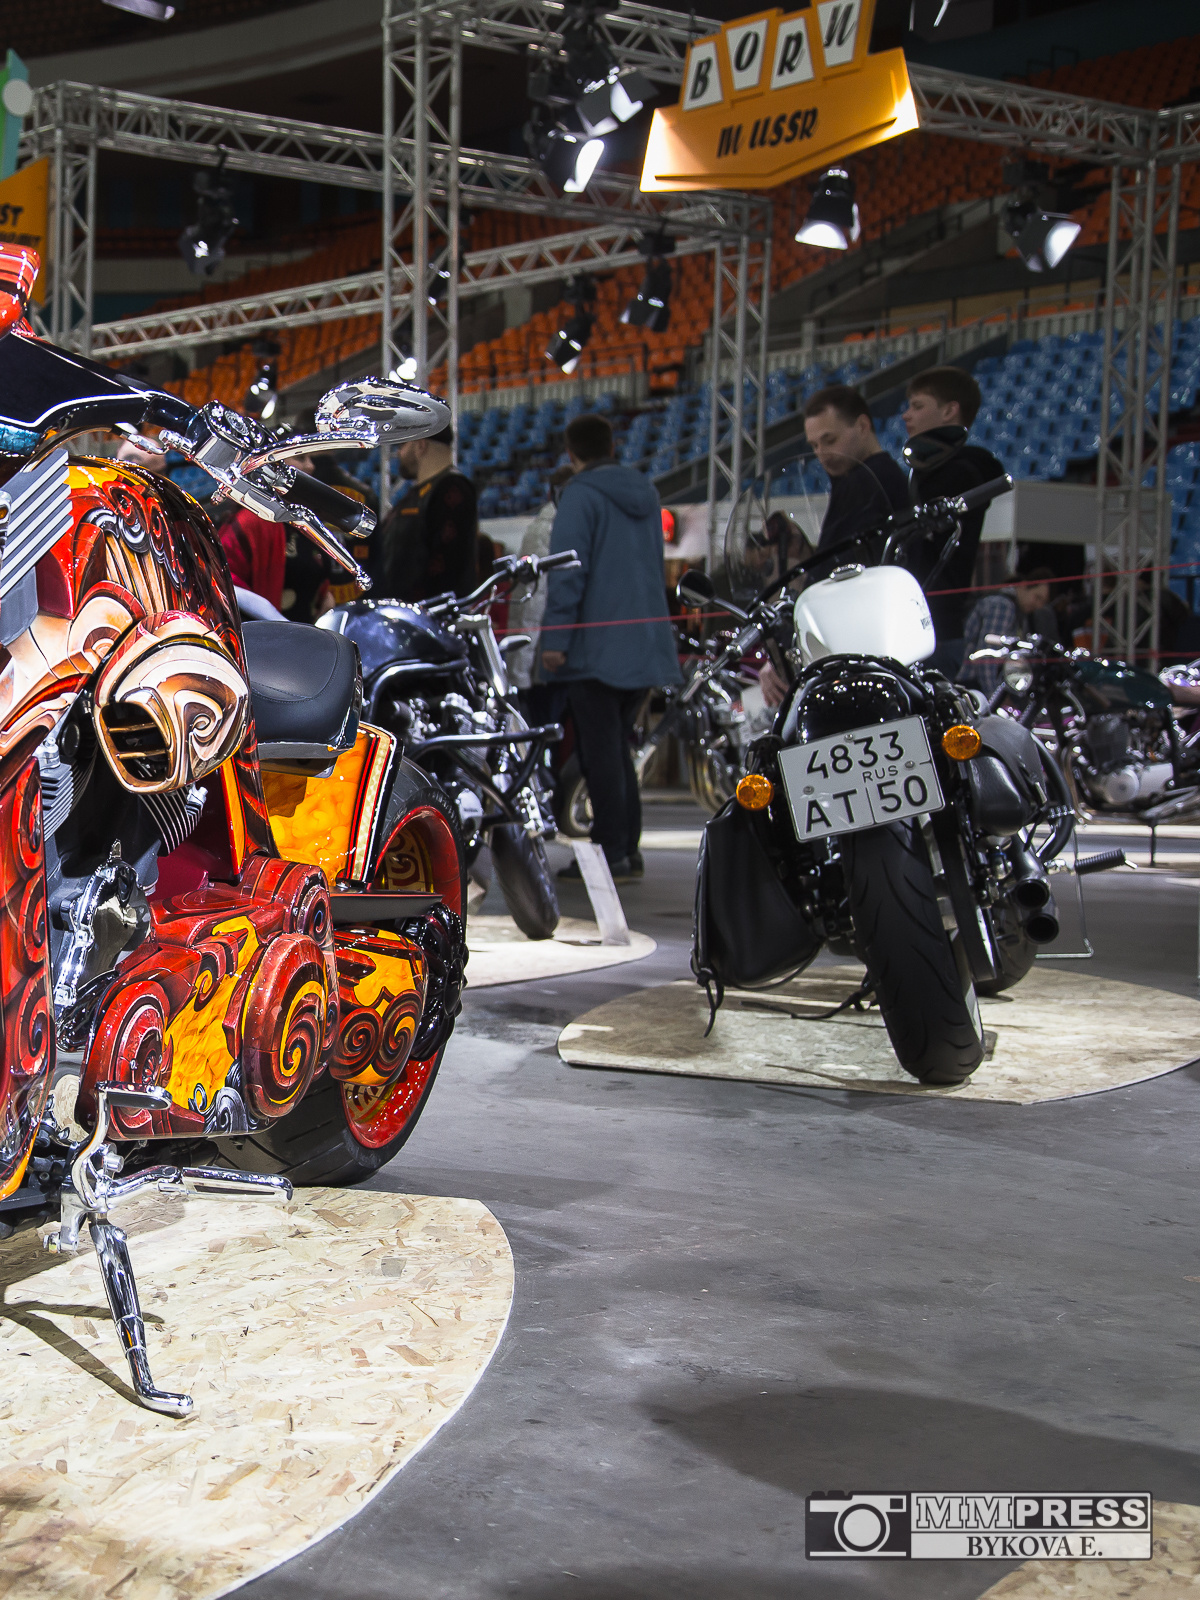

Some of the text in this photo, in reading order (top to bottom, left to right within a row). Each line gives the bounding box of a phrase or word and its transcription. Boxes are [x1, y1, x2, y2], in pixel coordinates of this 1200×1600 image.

[689, 2, 858, 101] BORN
[716, 106, 819, 158] IN USSR
[806, 730, 905, 780] 4833
[862, 765, 899, 784] RUS
[805, 775, 928, 834] AT 50
